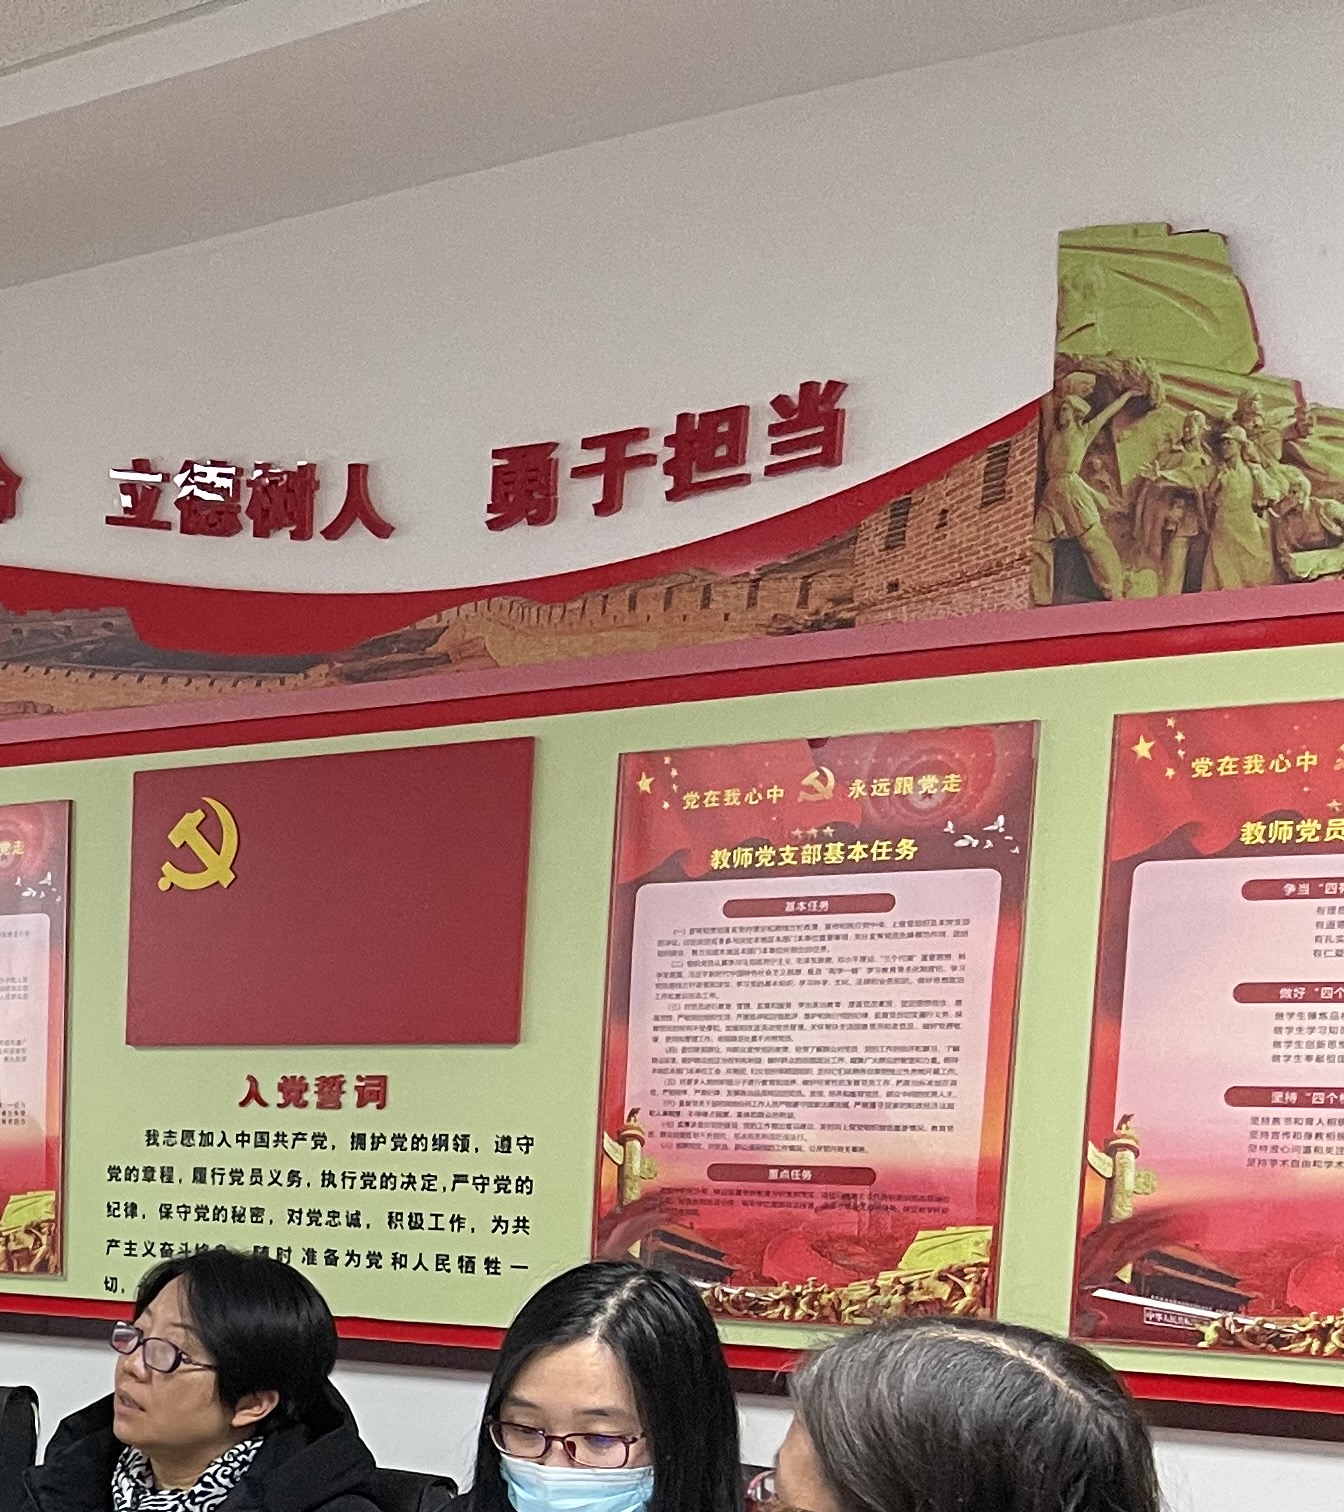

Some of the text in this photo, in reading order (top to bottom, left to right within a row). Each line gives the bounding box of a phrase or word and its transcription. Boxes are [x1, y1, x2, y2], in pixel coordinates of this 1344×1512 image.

[105, 458, 396, 541] 立德树人
[485, 380, 848, 532] 勇于担当
[1191, 751, 1318, 778] 党在我心中
[682, 773, 962, 810] 党在我心中 永远跟党走
[1240, 818, 1344, 845] 教师党员
[710, 838, 918, 869] 教师党支部基本任务
[239, 1074, 388, 1110] 入党誓词
